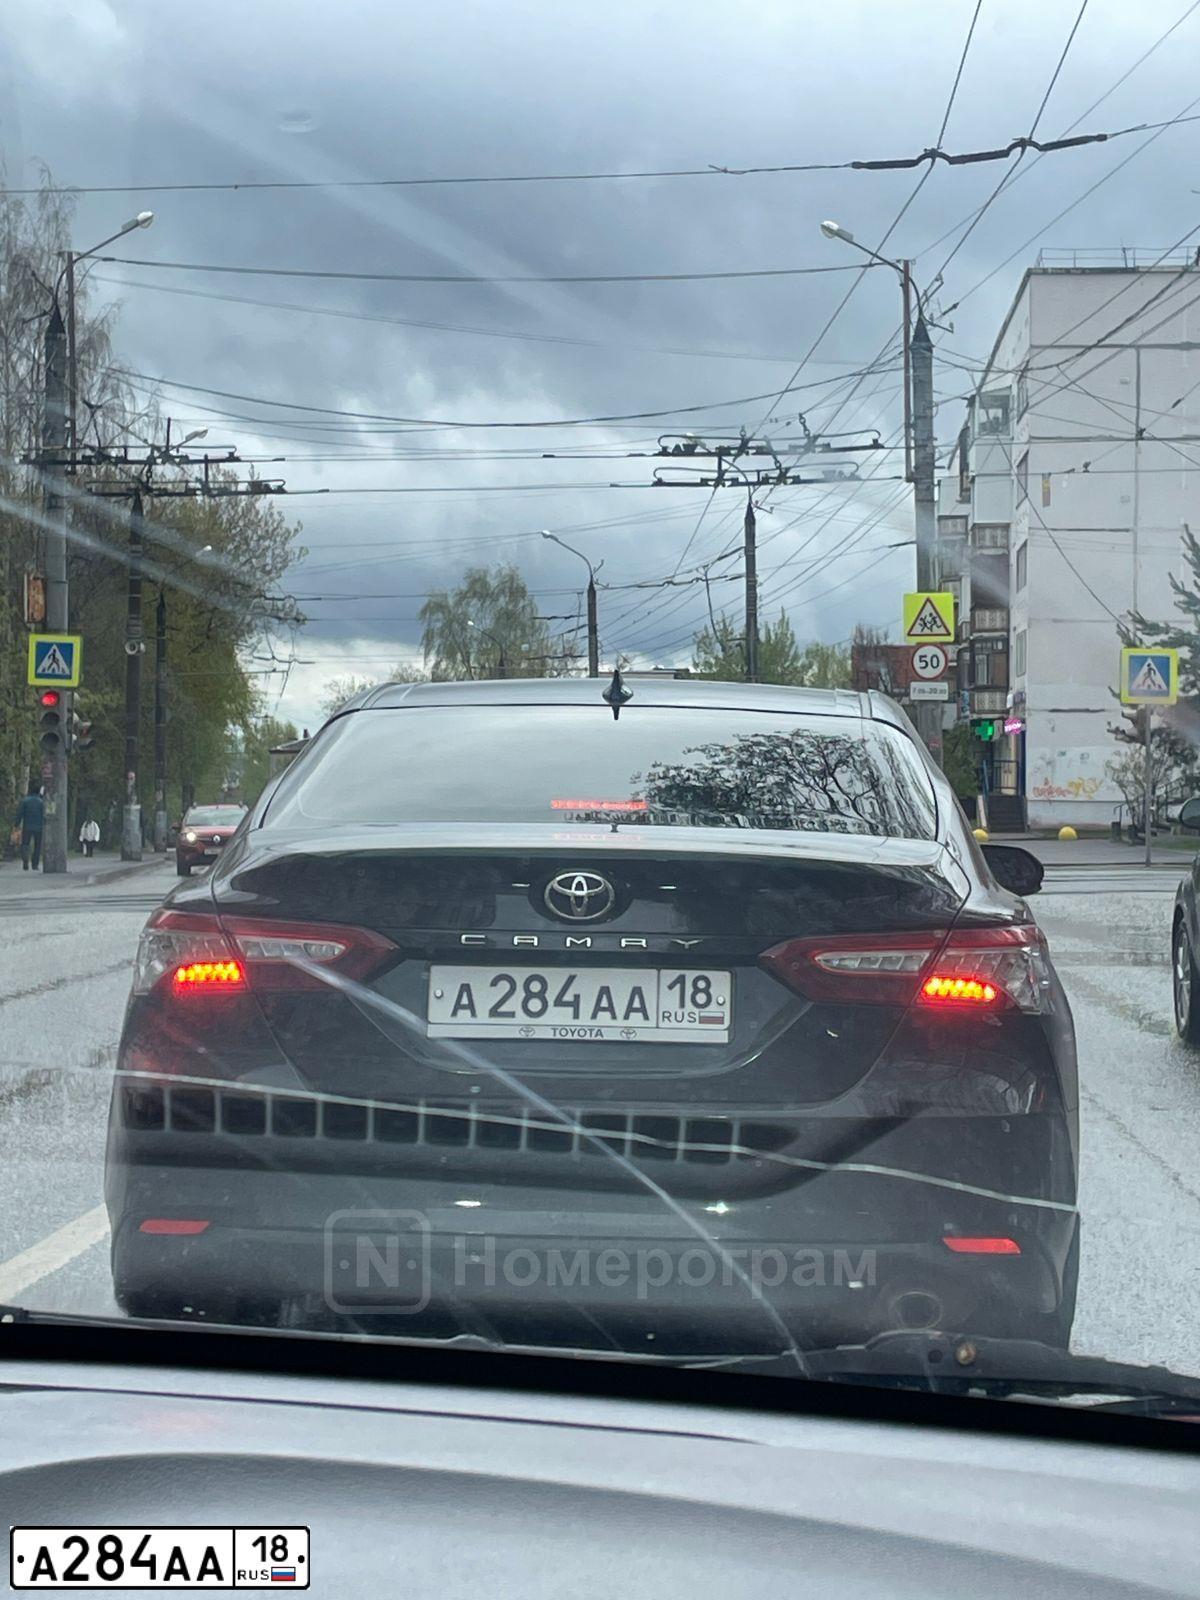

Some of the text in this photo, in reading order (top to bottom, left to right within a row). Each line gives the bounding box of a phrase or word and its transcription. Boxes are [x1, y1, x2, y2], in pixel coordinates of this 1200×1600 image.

[919, 654, 940, 669] 50
[461, 934, 703, 948] CAMRY
[450, 973, 713, 1021] А284АА 18
[661, 1011, 697, 1024] RUS
[550, 1027, 604, 1039] TOYOTA
